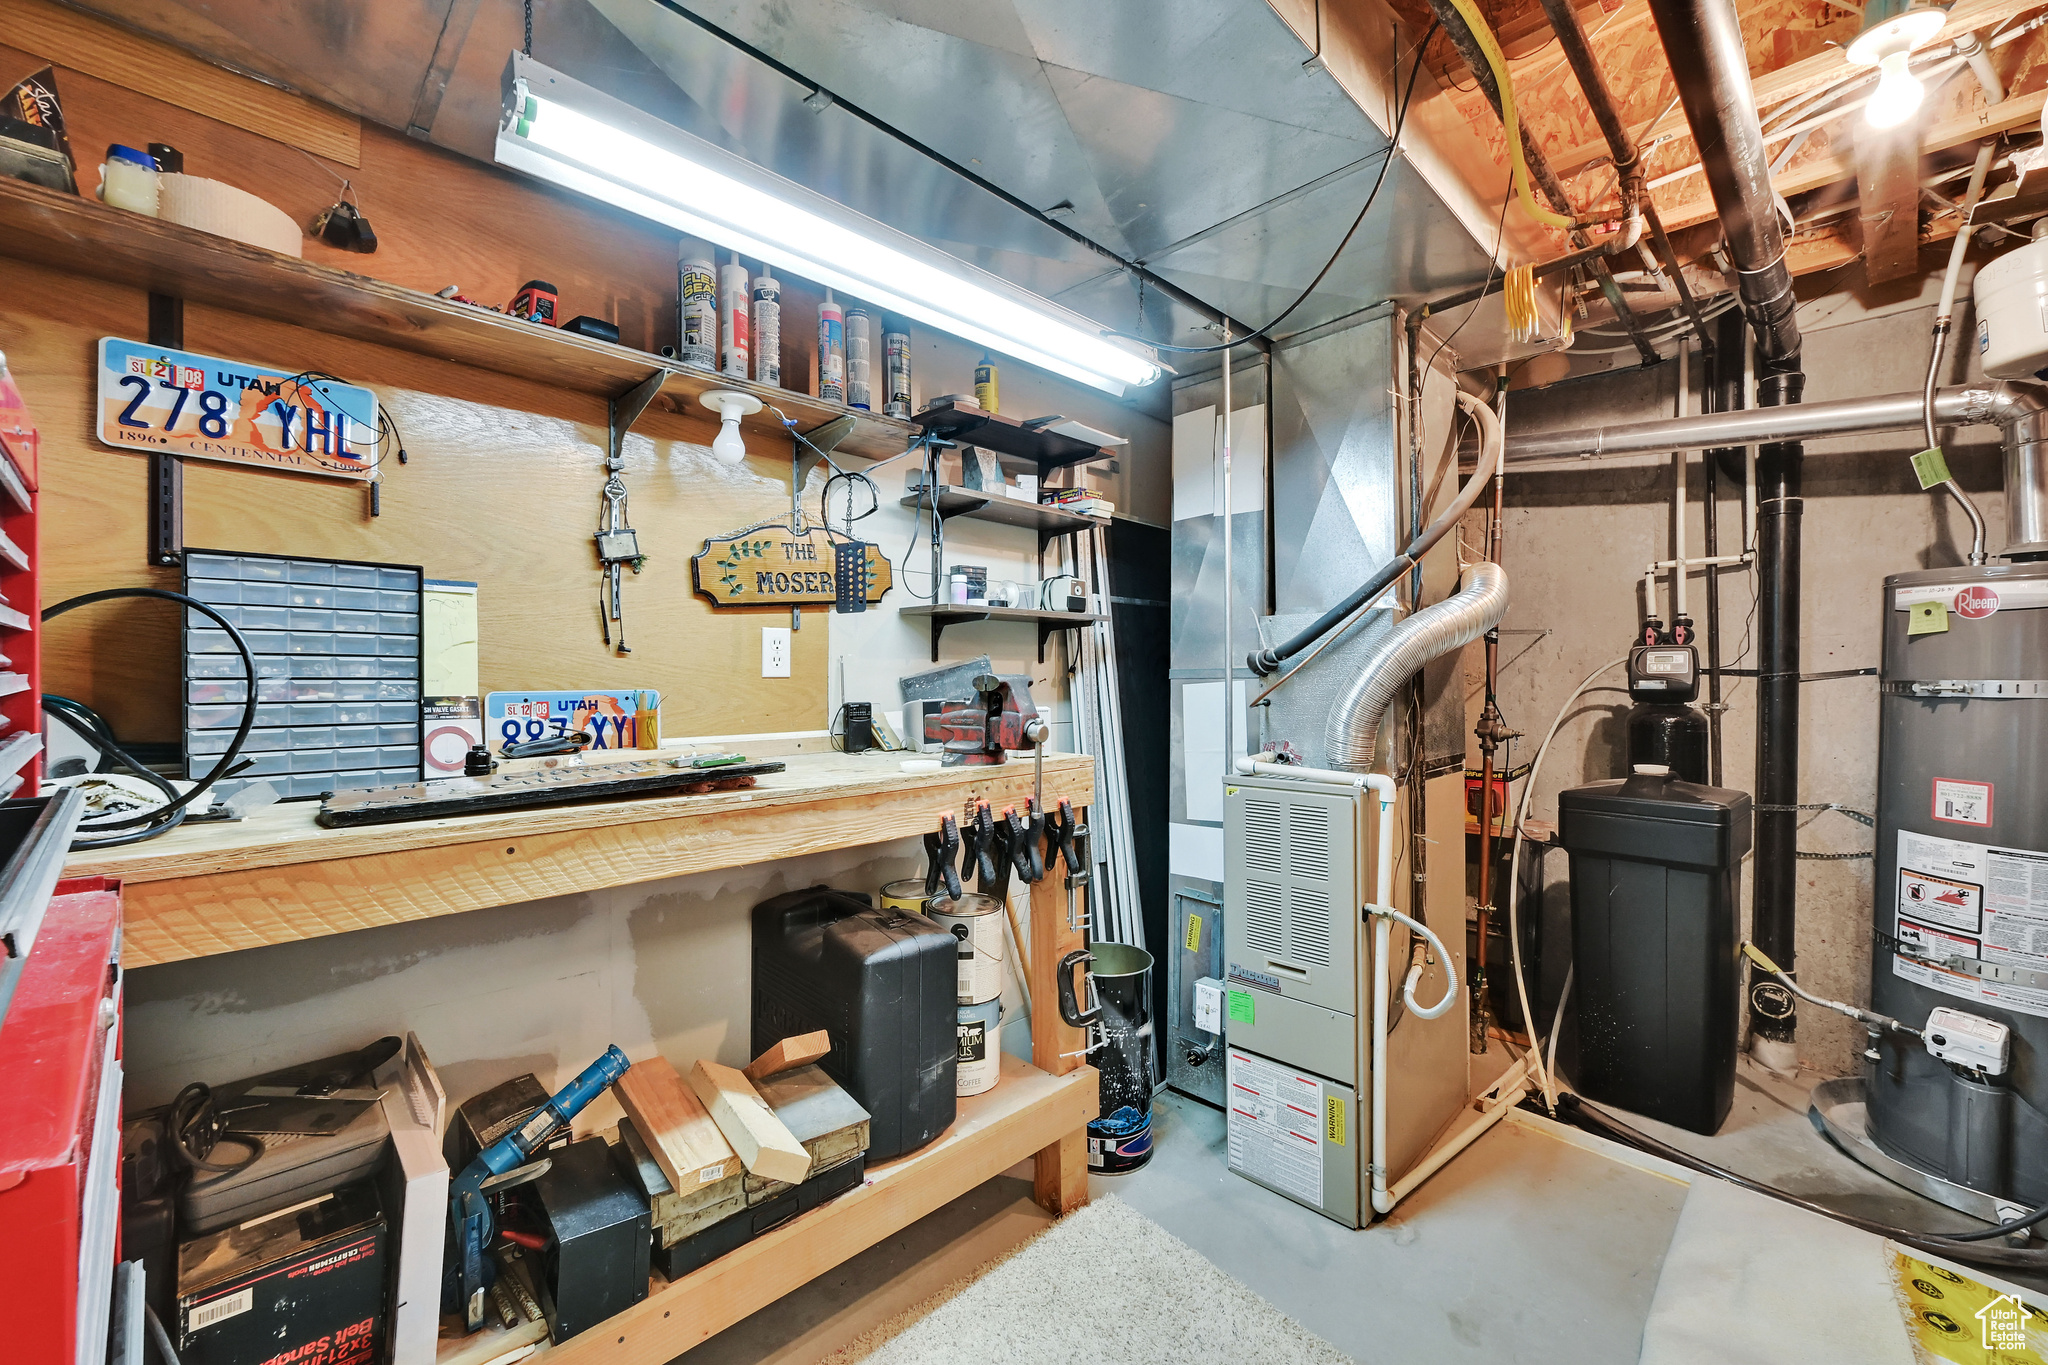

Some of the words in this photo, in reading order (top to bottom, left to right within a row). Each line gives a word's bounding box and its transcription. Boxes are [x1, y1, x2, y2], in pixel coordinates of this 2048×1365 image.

[683, 272, 717, 288] FLEX
[762, 289, 775, 298] DAP
[185, 369, 202, 385] 08
[217, 371, 281, 396] UTAH
[118, 375, 228, 440] 278
[274, 401, 363, 461] YHL
[118, 430, 157, 445] 1896
[189, 440, 306, 467] CENTENNIAL
[781, 542, 817, 561] THE
[756, 571, 836, 595] MOSER
[1958, 586, 1998, 615] Rheem
[507, 707, 518, 716] SL
[521, 704, 530, 716] 12
[536, 703, 547, 714] 08
[558, 700, 599, 712] UTAH
[1186, 916, 1195, 947] WARNING
[1925, 929, 1950, 939] DANGER
[1328, 1098, 1336, 1139] WARNING
[309, 1248, 358, 1271] CRAFTSMAN
[335, 1257, 348, 1269] job
[348, 1254, 361, 1264] the
[287, 1265, 308, 1279] tools
[335, 1316, 374, 1342] Belt
